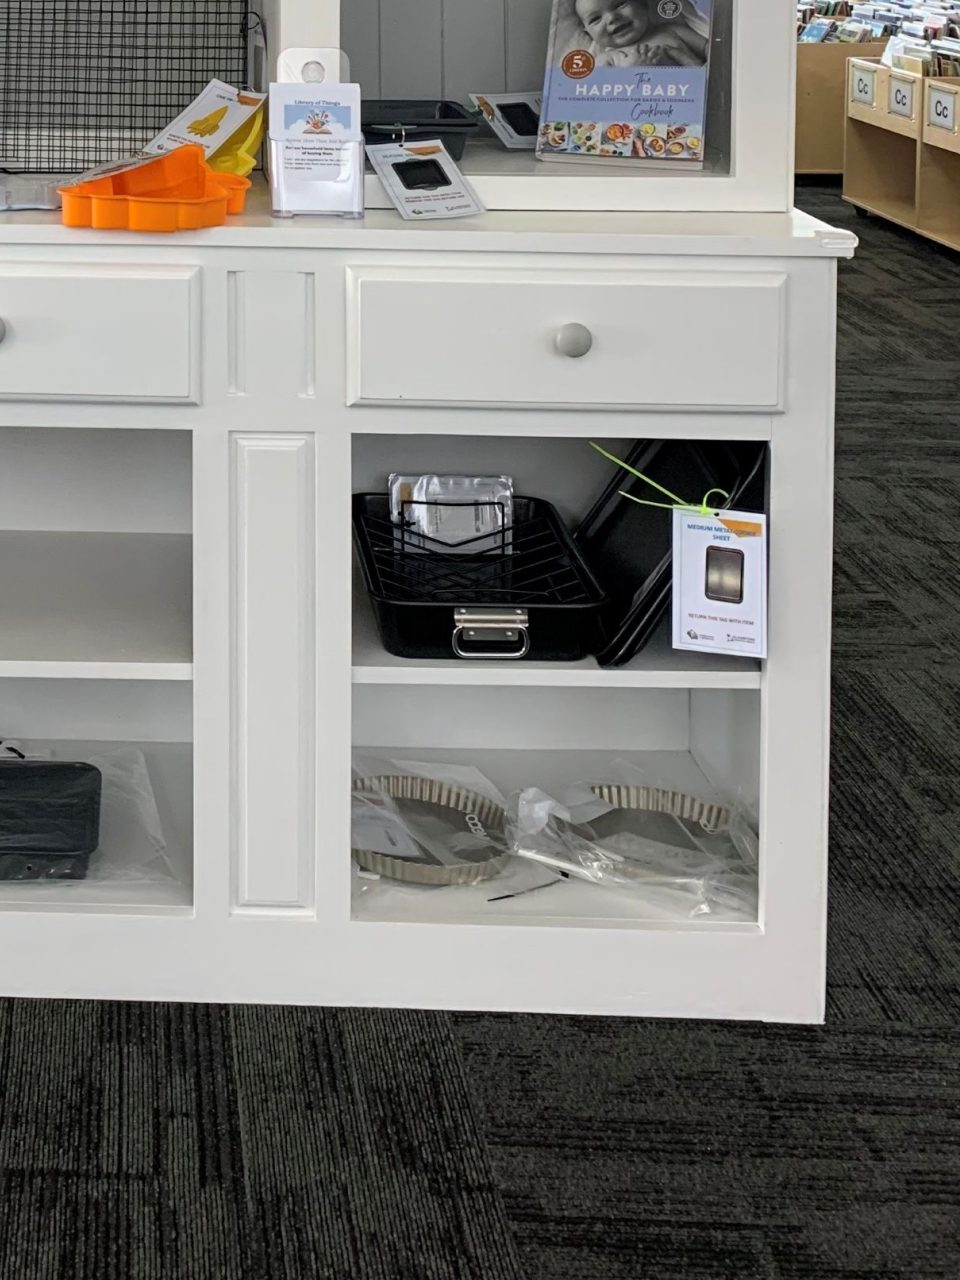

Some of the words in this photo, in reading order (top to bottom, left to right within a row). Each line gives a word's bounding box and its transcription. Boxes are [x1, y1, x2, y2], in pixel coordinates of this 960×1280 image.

[575, 83, 635, 96] HAPPY
[642, 83, 689, 96] BABY
[857, 78, 868, 94] Cc
[895, 89, 907, 106] Cc
[630, 102, 674, 121] Cookbook
[935, 100, 948, 118] Cc
[687, 523, 713, 532] MEDIUM
[712, 534, 731, 542] SHEET
